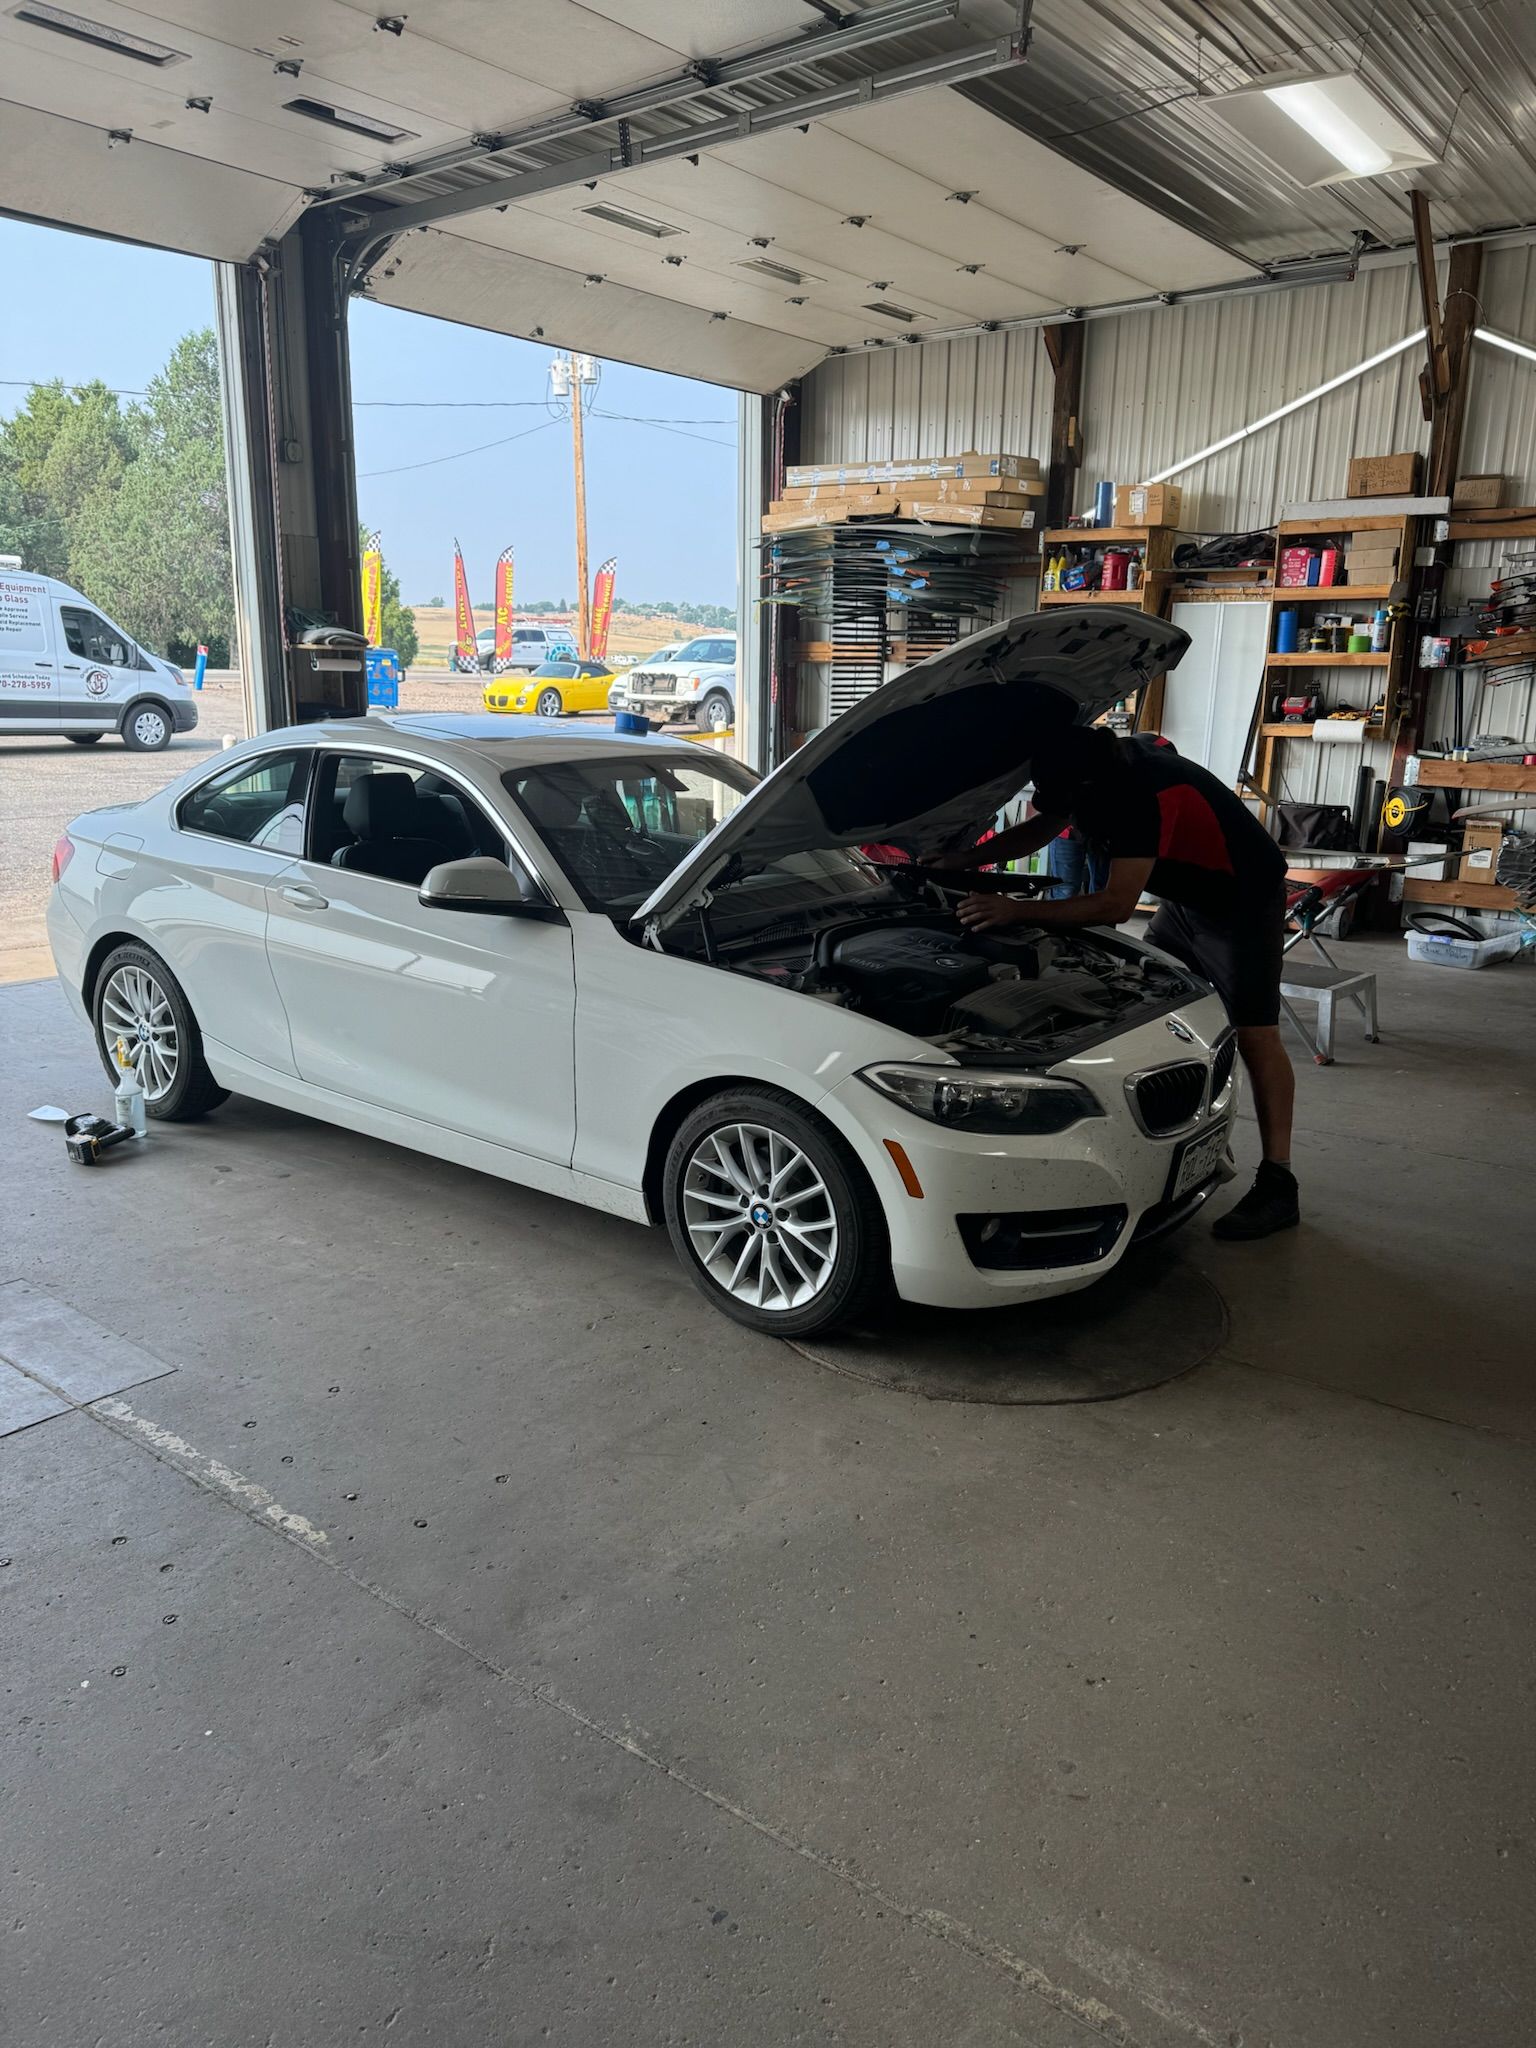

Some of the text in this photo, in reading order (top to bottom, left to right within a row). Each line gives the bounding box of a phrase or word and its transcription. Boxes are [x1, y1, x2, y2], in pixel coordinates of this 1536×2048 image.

[0, 582, 46, 594] Equipment
[4, 594, 29, 604] Glass
[497, 607, 508, 625] AC
